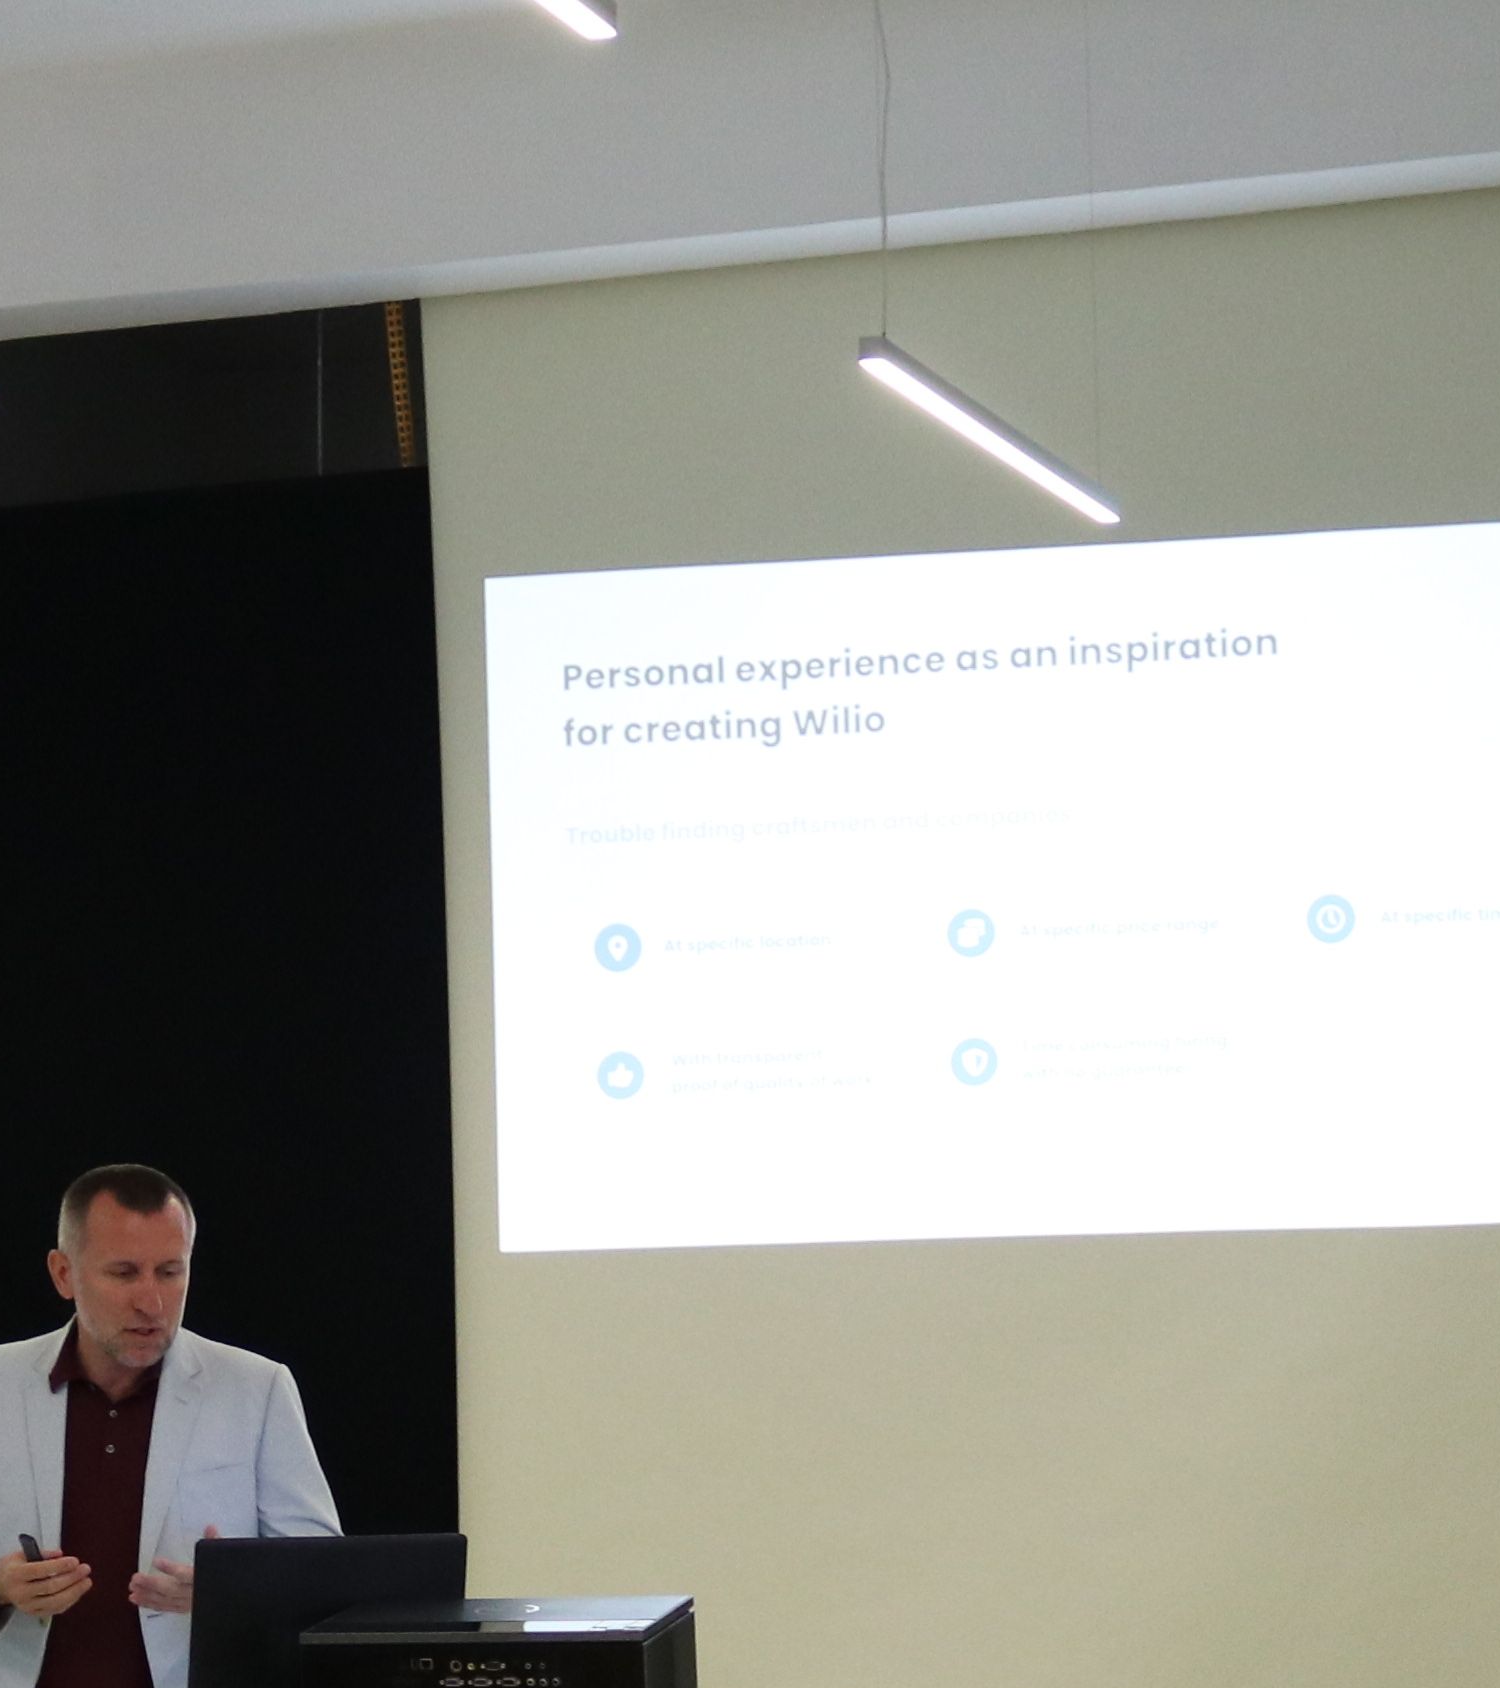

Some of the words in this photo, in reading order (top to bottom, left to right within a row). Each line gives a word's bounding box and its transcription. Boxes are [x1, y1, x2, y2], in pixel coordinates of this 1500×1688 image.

[562, 655, 726, 692] Personal
[736, 647, 946, 690] experience
[955, 648, 999, 672] as
[1009, 645, 1058, 669] an
[1069, 627, 1280, 673] inspiration
[562, 717, 614, 748] for
[623, 709, 782, 748] creating
[792, 703, 886, 737] Wilio
[566, 823, 656, 846] Trouble
[661, 817, 746, 843] finding
[883, 809, 930, 832] and
[687, 934, 755, 956] specific
